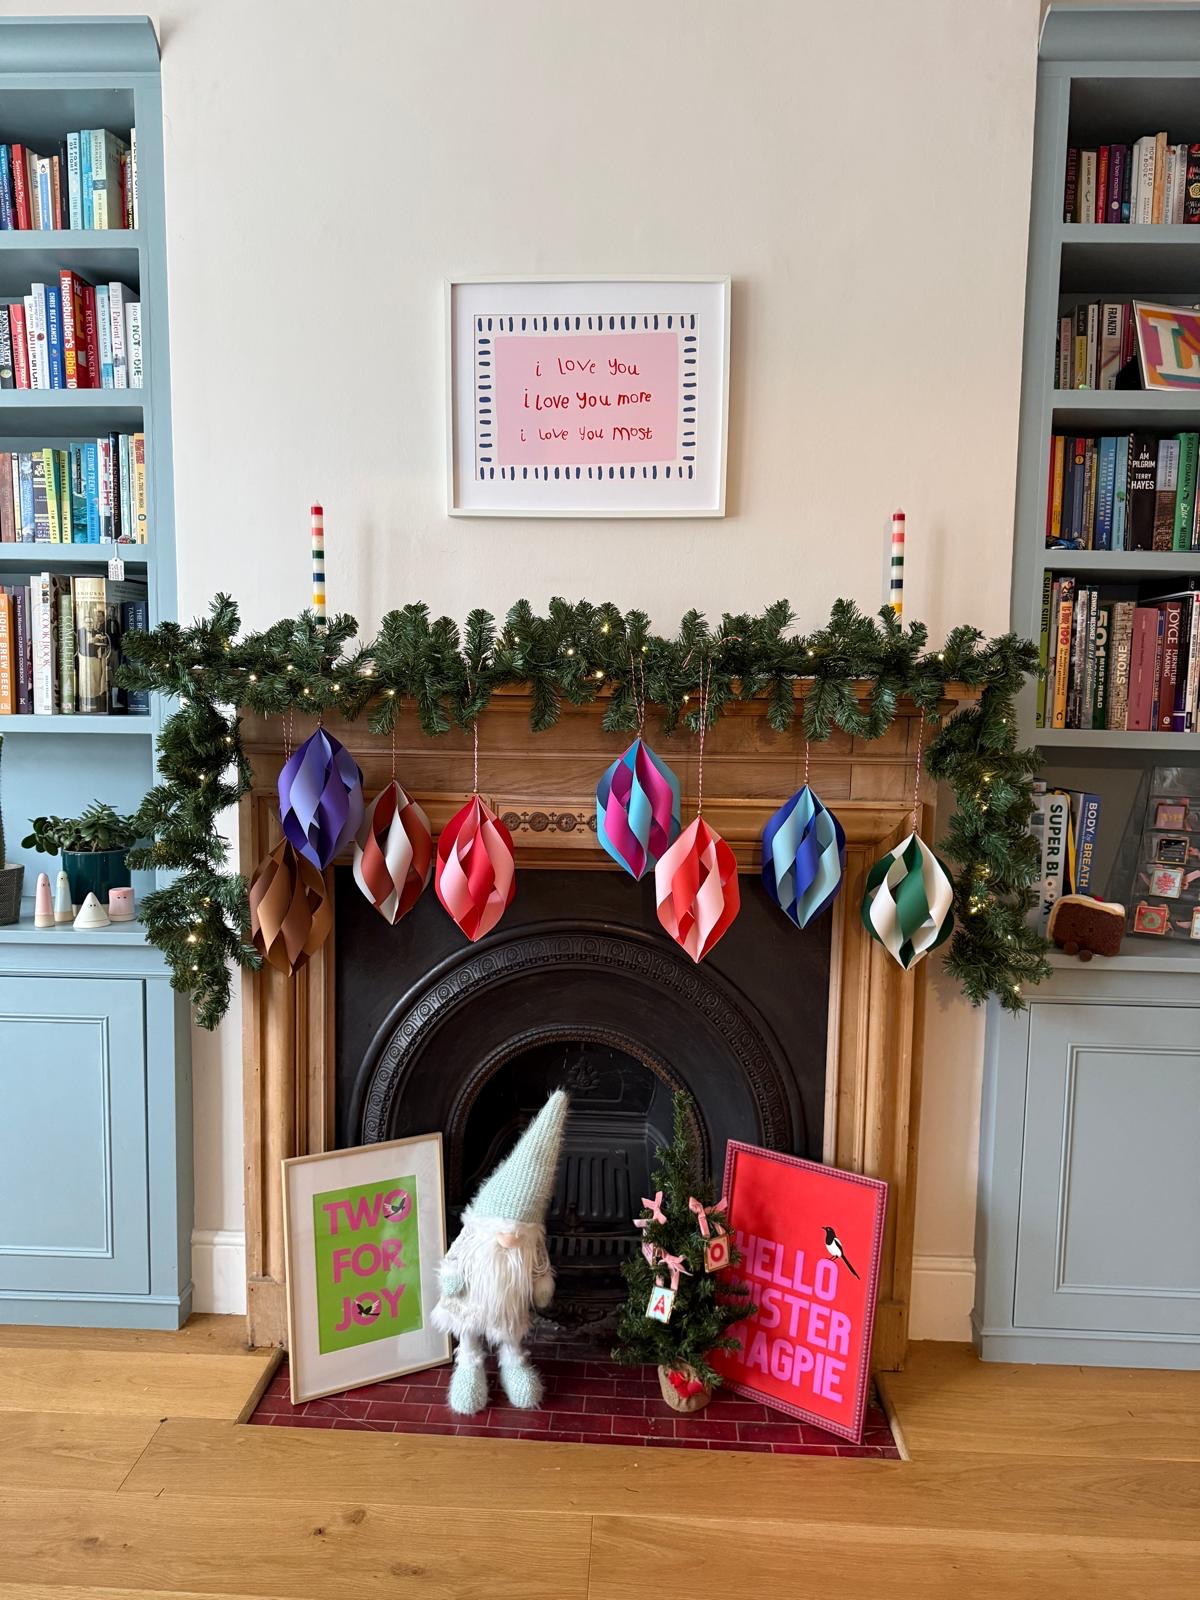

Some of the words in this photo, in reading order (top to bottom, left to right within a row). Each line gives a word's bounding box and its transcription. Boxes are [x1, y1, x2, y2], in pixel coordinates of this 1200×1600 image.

[1067, 148, 1077, 181] KILLING
[1066, 184, 1075, 210] PABLO
[48, 291, 56, 308] CHRIS
[61, 277, 74, 349] Housebuilder's
[2, 310, 10, 338] DONNA
[49, 308, 57, 323] BEAT
[85, 310, 93, 335] KETO
[112, 311, 121, 339] Patient
[1107, 307, 1117, 336] FRANZEN
[114, 341, 122, 350] 71
[132, 324, 141, 347] NOT
[66, 350, 76, 376] Bible
[87, 344, 95, 378] CANCER
[133, 359, 142, 377] DIE
[536, 361, 542, 377] i
[558, 357, 596, 375] love
[608, 358, 640, 376] you
[68, 377, 77, 389] 10
[524, 388, 530, 409] i
[535, 394, 570, 411] love
[576, 392, 612, 410] you
[617, 391, 652, 407] more
[520, 428, 527, 442] i
[538, 428, 569, 441] love
[578, 426, 604, 441] you
[612, 426, 653, 441] most
[87, 447, 95, 471] FEEDING
[1132, 460, 1155, 468] PILGRIM
[1185, 437, 1194, 463] RICHARD
[1131, 480, 1154, 490] HAYES
[1184, 463, 1192, 487] OSMAN
[1104, 493, 1112, 529] ADVANTAGE
[1042, 577, 1050, 605] SHARP
[1090, 591, 1098, 616] REINHOLD
[1041, 608, 1049, 633] SUITS
[1095, 610, 1108, 657] 501
[1167, 608, 1180, 644] JOYCE
[65, 615, 73, 671] COMPLETE
[1060, 625, 1070, 645] 100
[1116, 645, 1128, 684] STONE
[1164, 649, 1172, 677] MAKING
[1170, 649, 1178, 685] FURNITURE
[1097, 658, 1105, 708] MUST-READ
[1046, 804, 1063, 856] SUPER
[1086, 802, 1098, 834] BODY
[1080, 843, 1093, 887] BREATH
[322, 1188, 412, 1236] TWO
[332, 1238, 407, 1284] FOR
[735, 1230, 839, 1302] HELLO
[335, 1284, 407, 1332] JOY
[653, 1294, 665, 1315] A
[726, 1322, 846, 1403] MAGPIE
